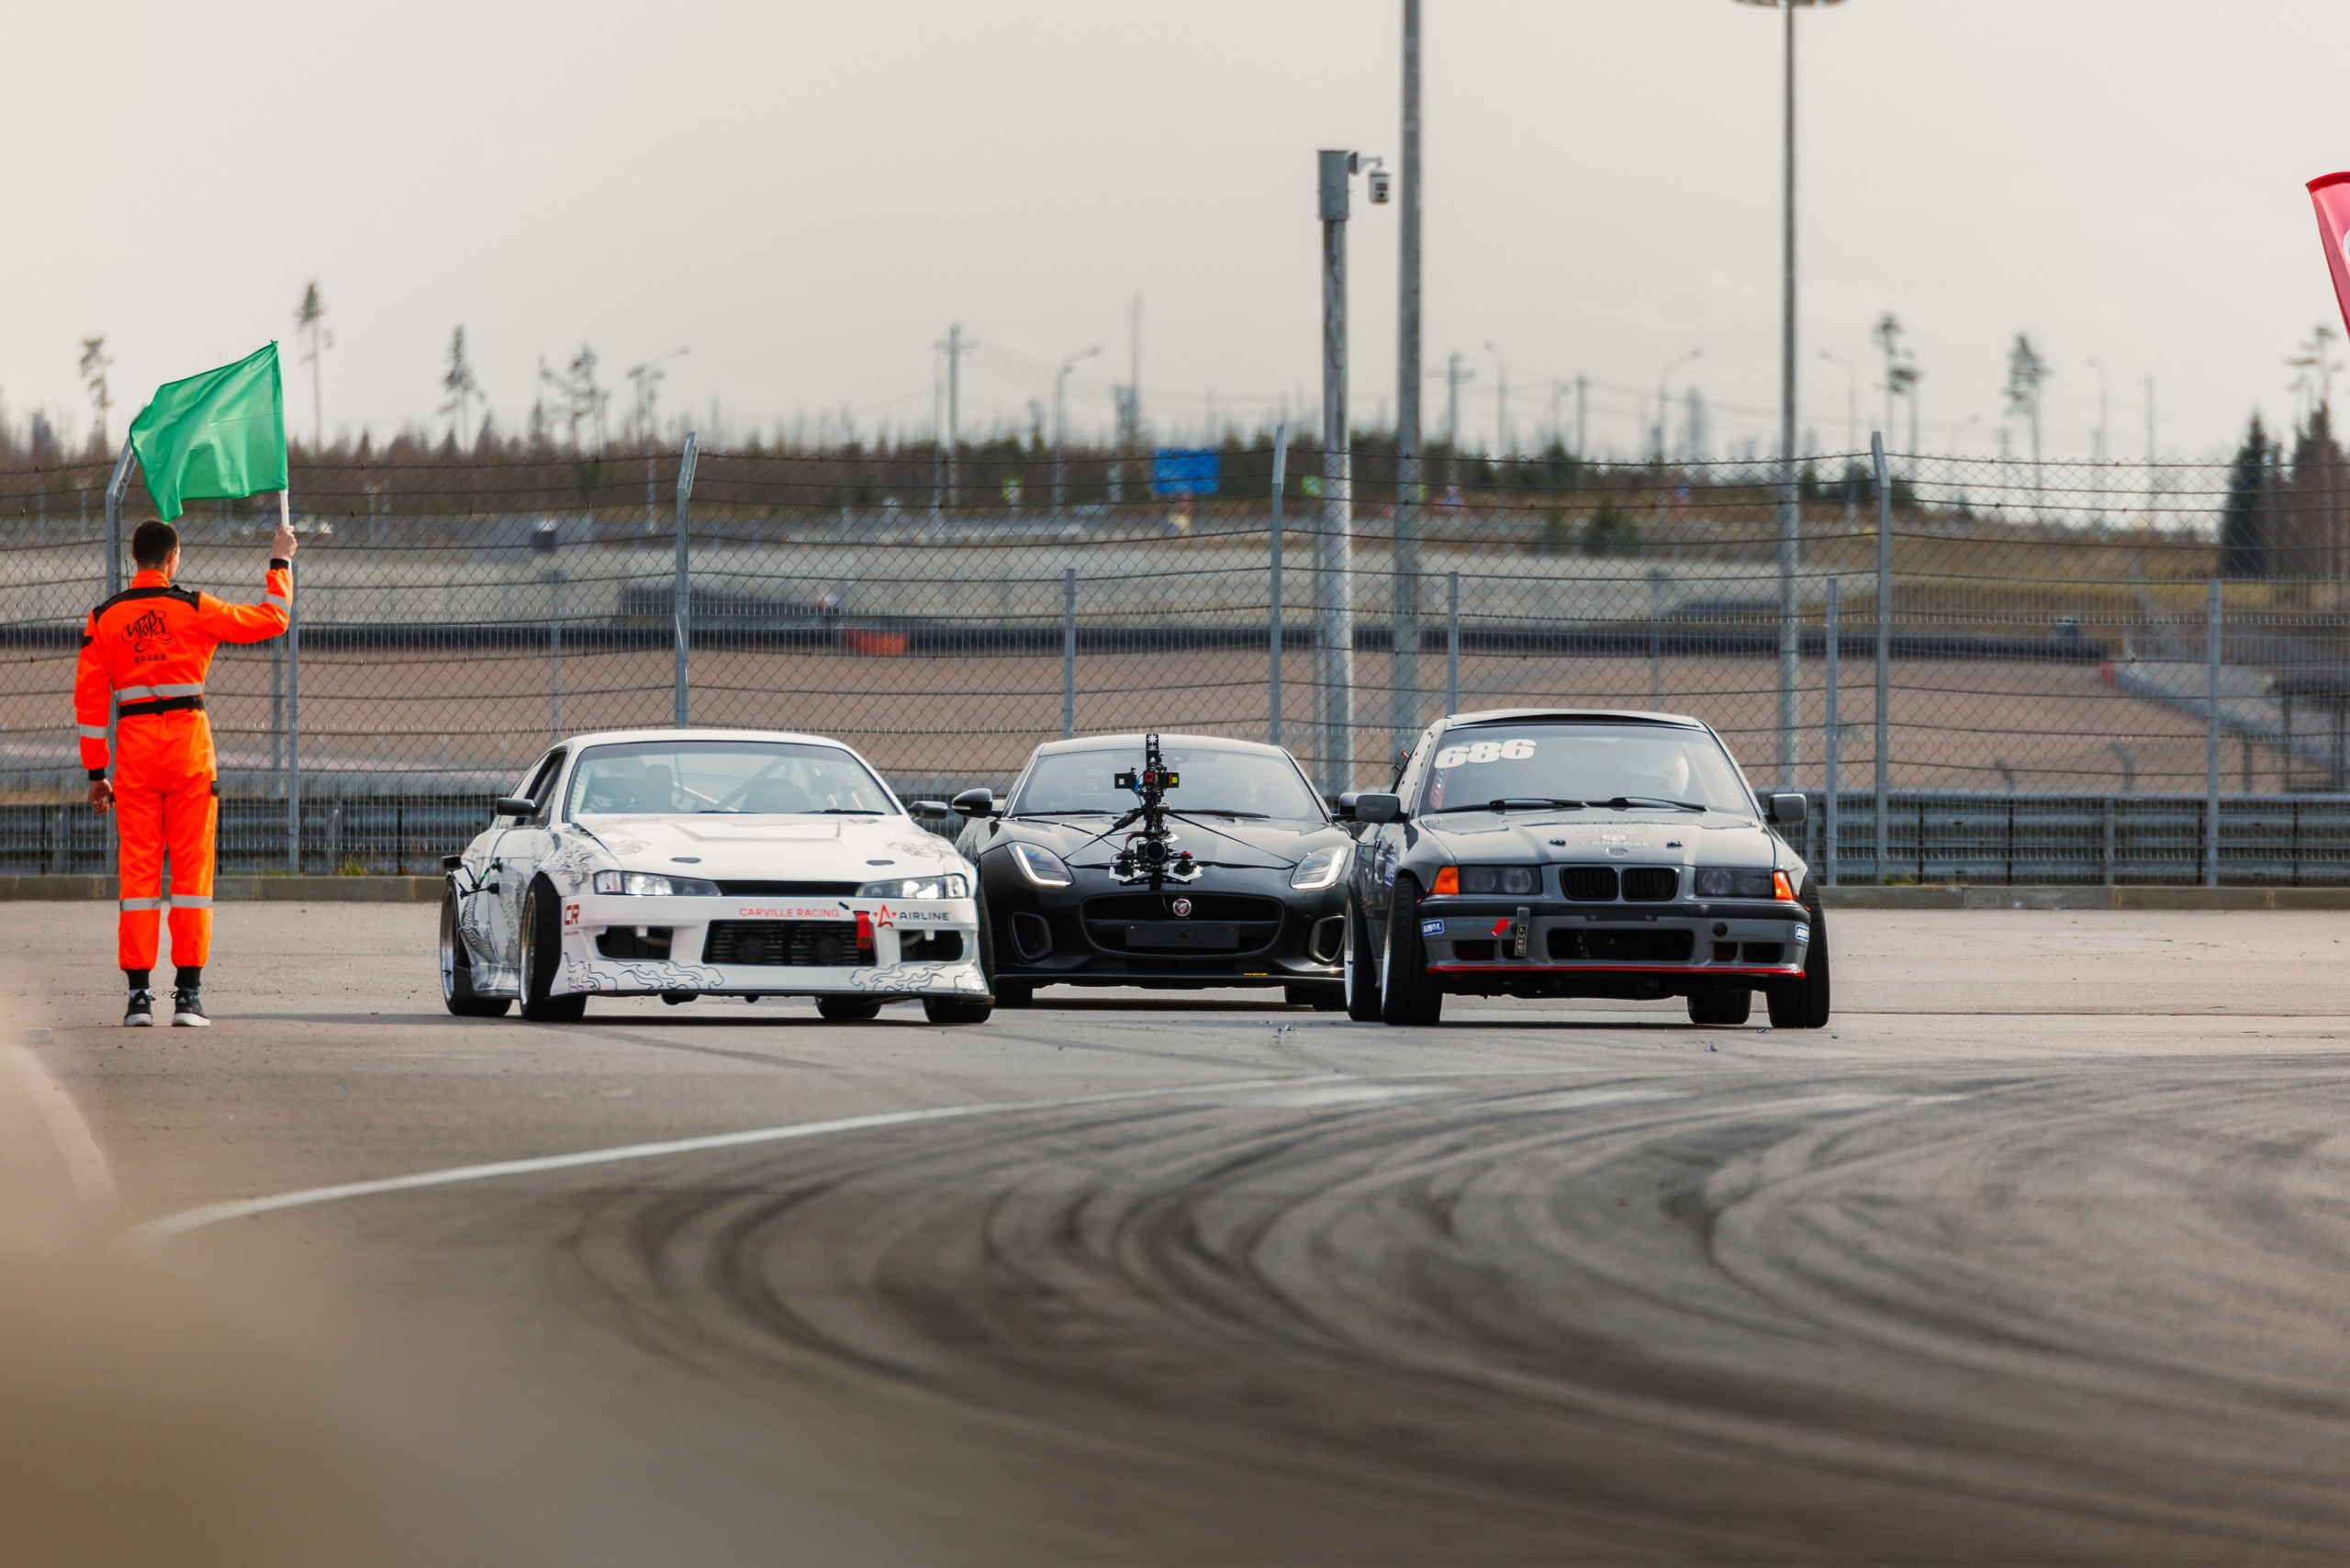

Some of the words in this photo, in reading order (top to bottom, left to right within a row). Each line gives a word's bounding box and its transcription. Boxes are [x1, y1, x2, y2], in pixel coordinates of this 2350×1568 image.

[134, 653, 166, 664] ДРАЙВ
[1434, 739, 1537, 769] 686
[565, 904, 580, 925] CR
[739, 908, 792, 917] CARVILLE
[797, 909, 840, 917] RACING
[900, 912, 949, 921] AIRLINE
